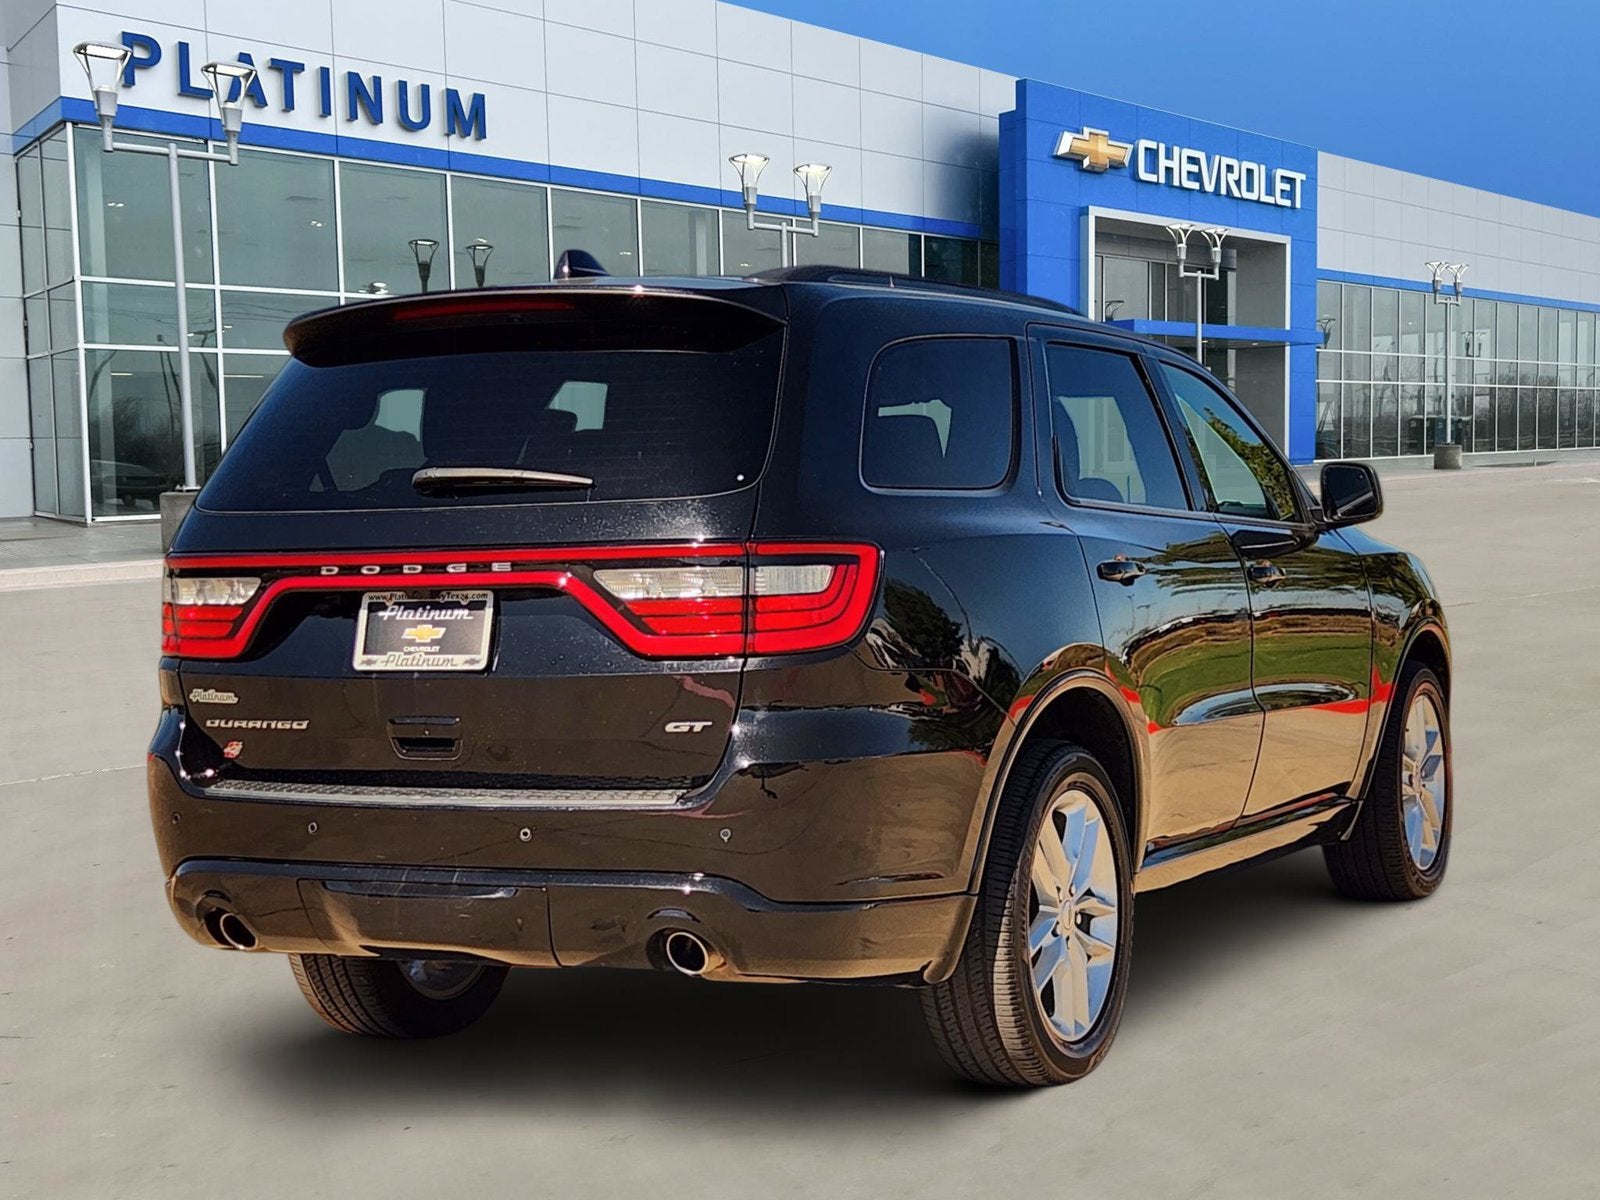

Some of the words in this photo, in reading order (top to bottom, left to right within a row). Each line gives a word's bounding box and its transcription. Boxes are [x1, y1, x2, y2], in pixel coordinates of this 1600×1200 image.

[120, 31, 488, 141] PLATINUM
[1136, 138, 1307, 209] CHEVROLET
[320, 562, 512, 575] DODGE
[378, 605, 474, 620] Platinum
[381, 652, 458, 667] Platinum
[190, 689, 237, 702] Platinum
[206, 719, 309, 729] DURANGO
[664, 721, 713, 733] GT
